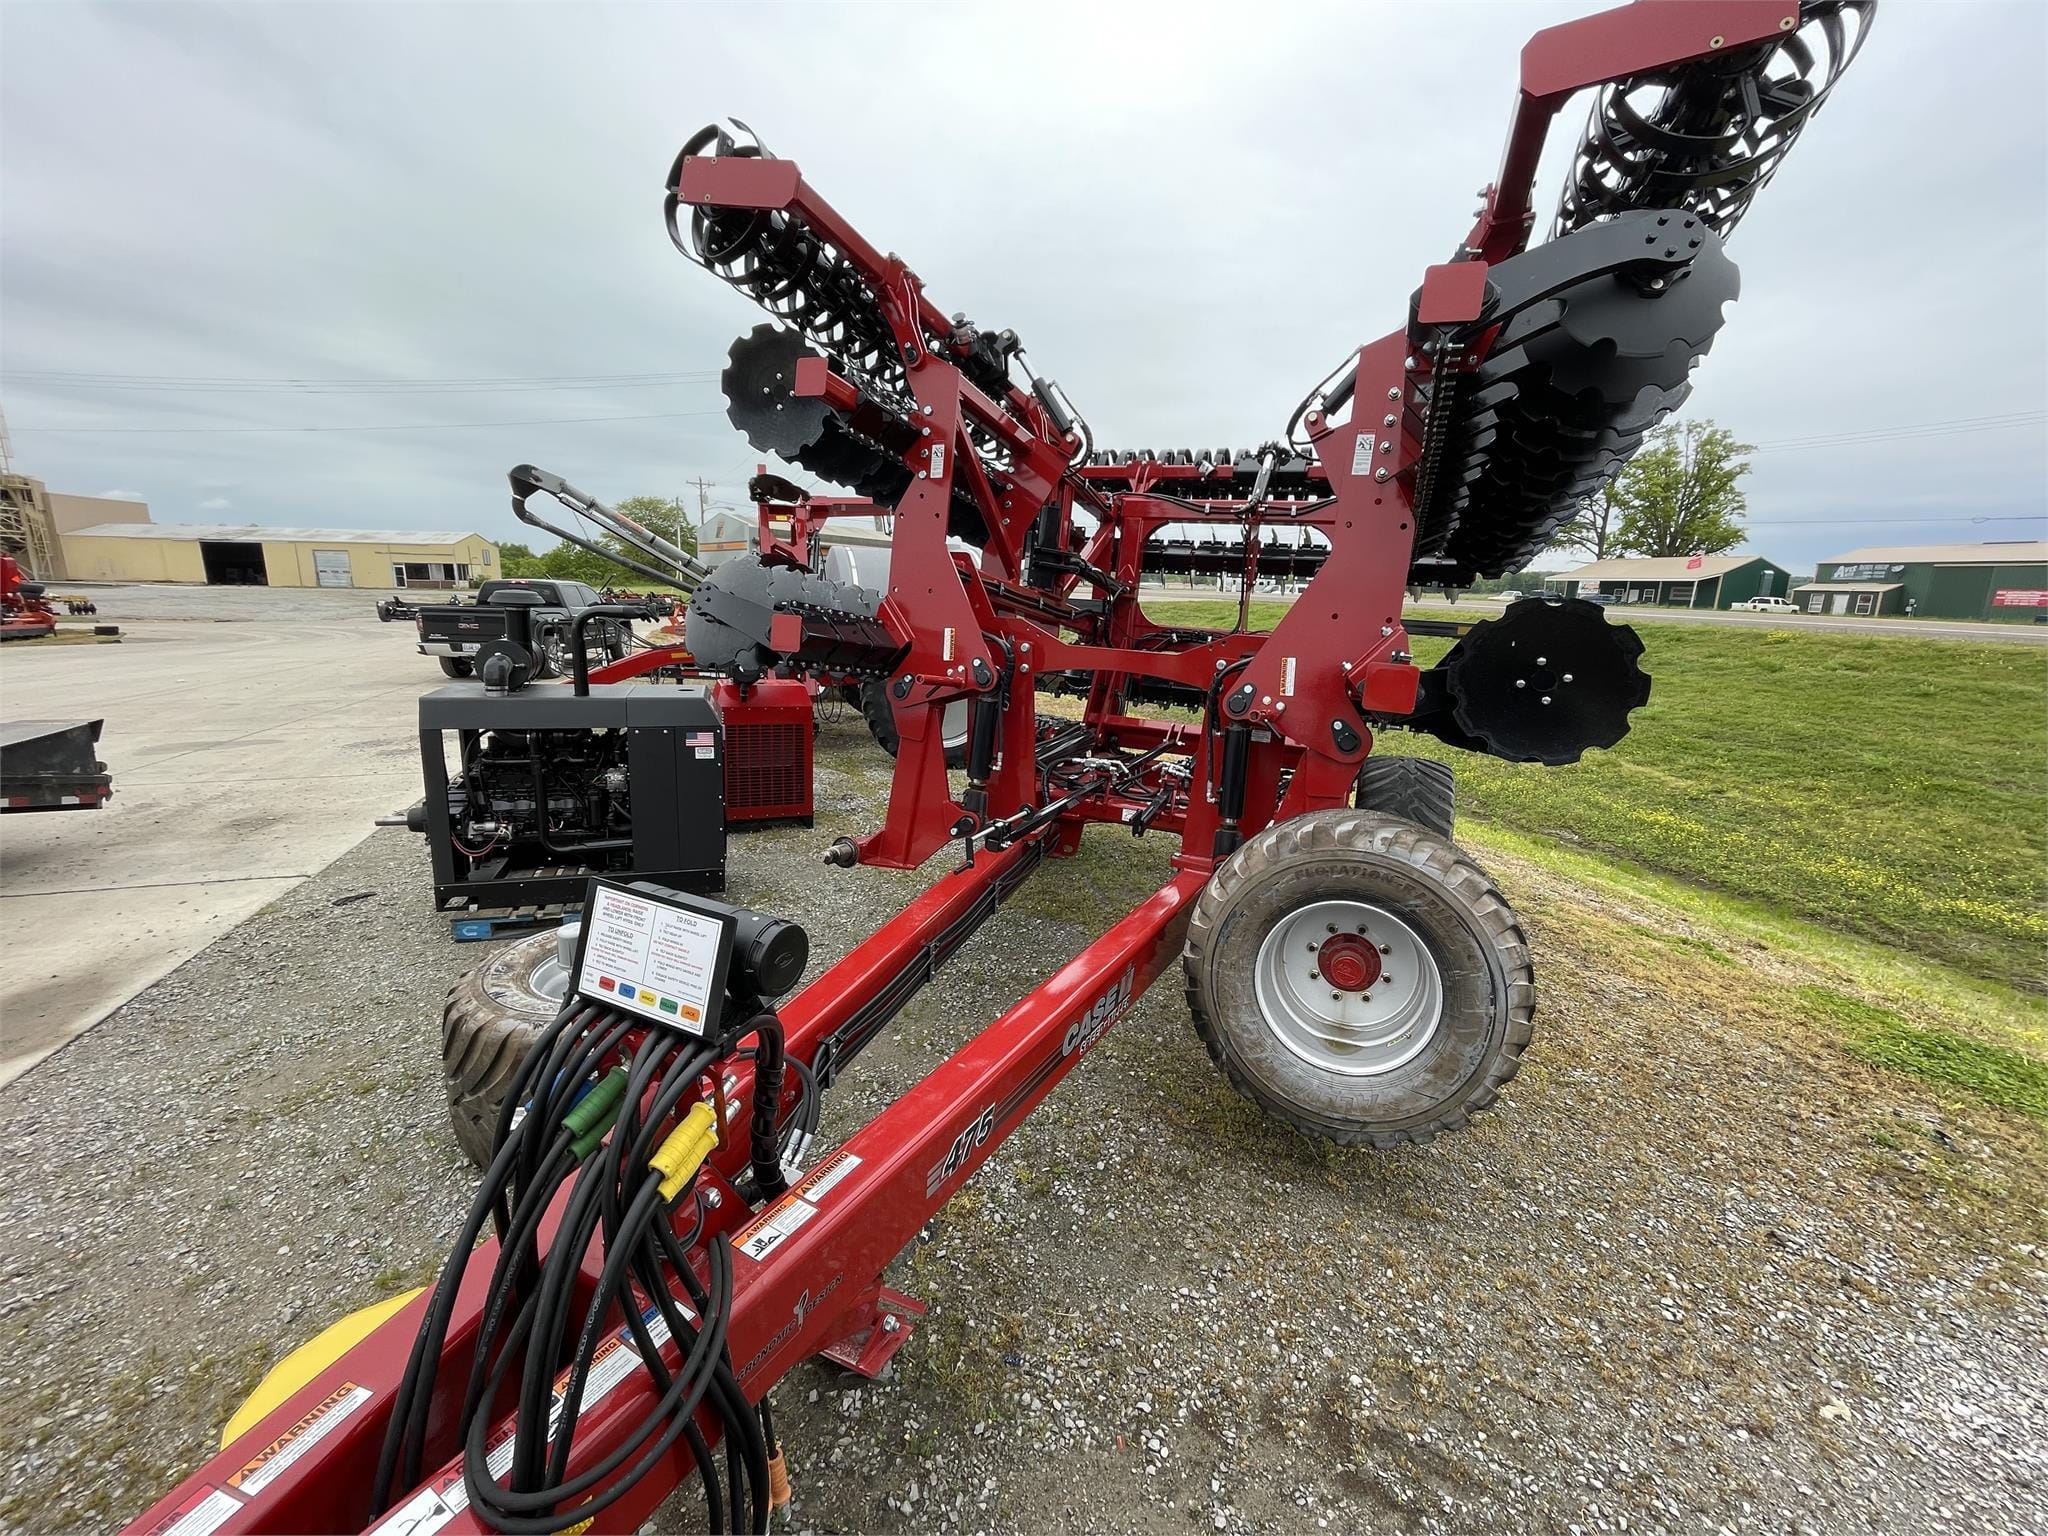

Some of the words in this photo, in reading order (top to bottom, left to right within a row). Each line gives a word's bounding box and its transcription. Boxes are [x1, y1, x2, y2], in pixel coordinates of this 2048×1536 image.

[683, 917, 697, 927] FOLD
[1062, 983, 1119, 1057] CASE
[941, 1102, 995, 1180] 475
[807, 1152, 849, 1187] WARNING
[752, 1203, 787, 1232] WARNING
[592, 1341, 618, 1365] NING
[737, 1318, 797, 1381] GRONOMIC
[255, 1386, 353, 1462] WARNING
